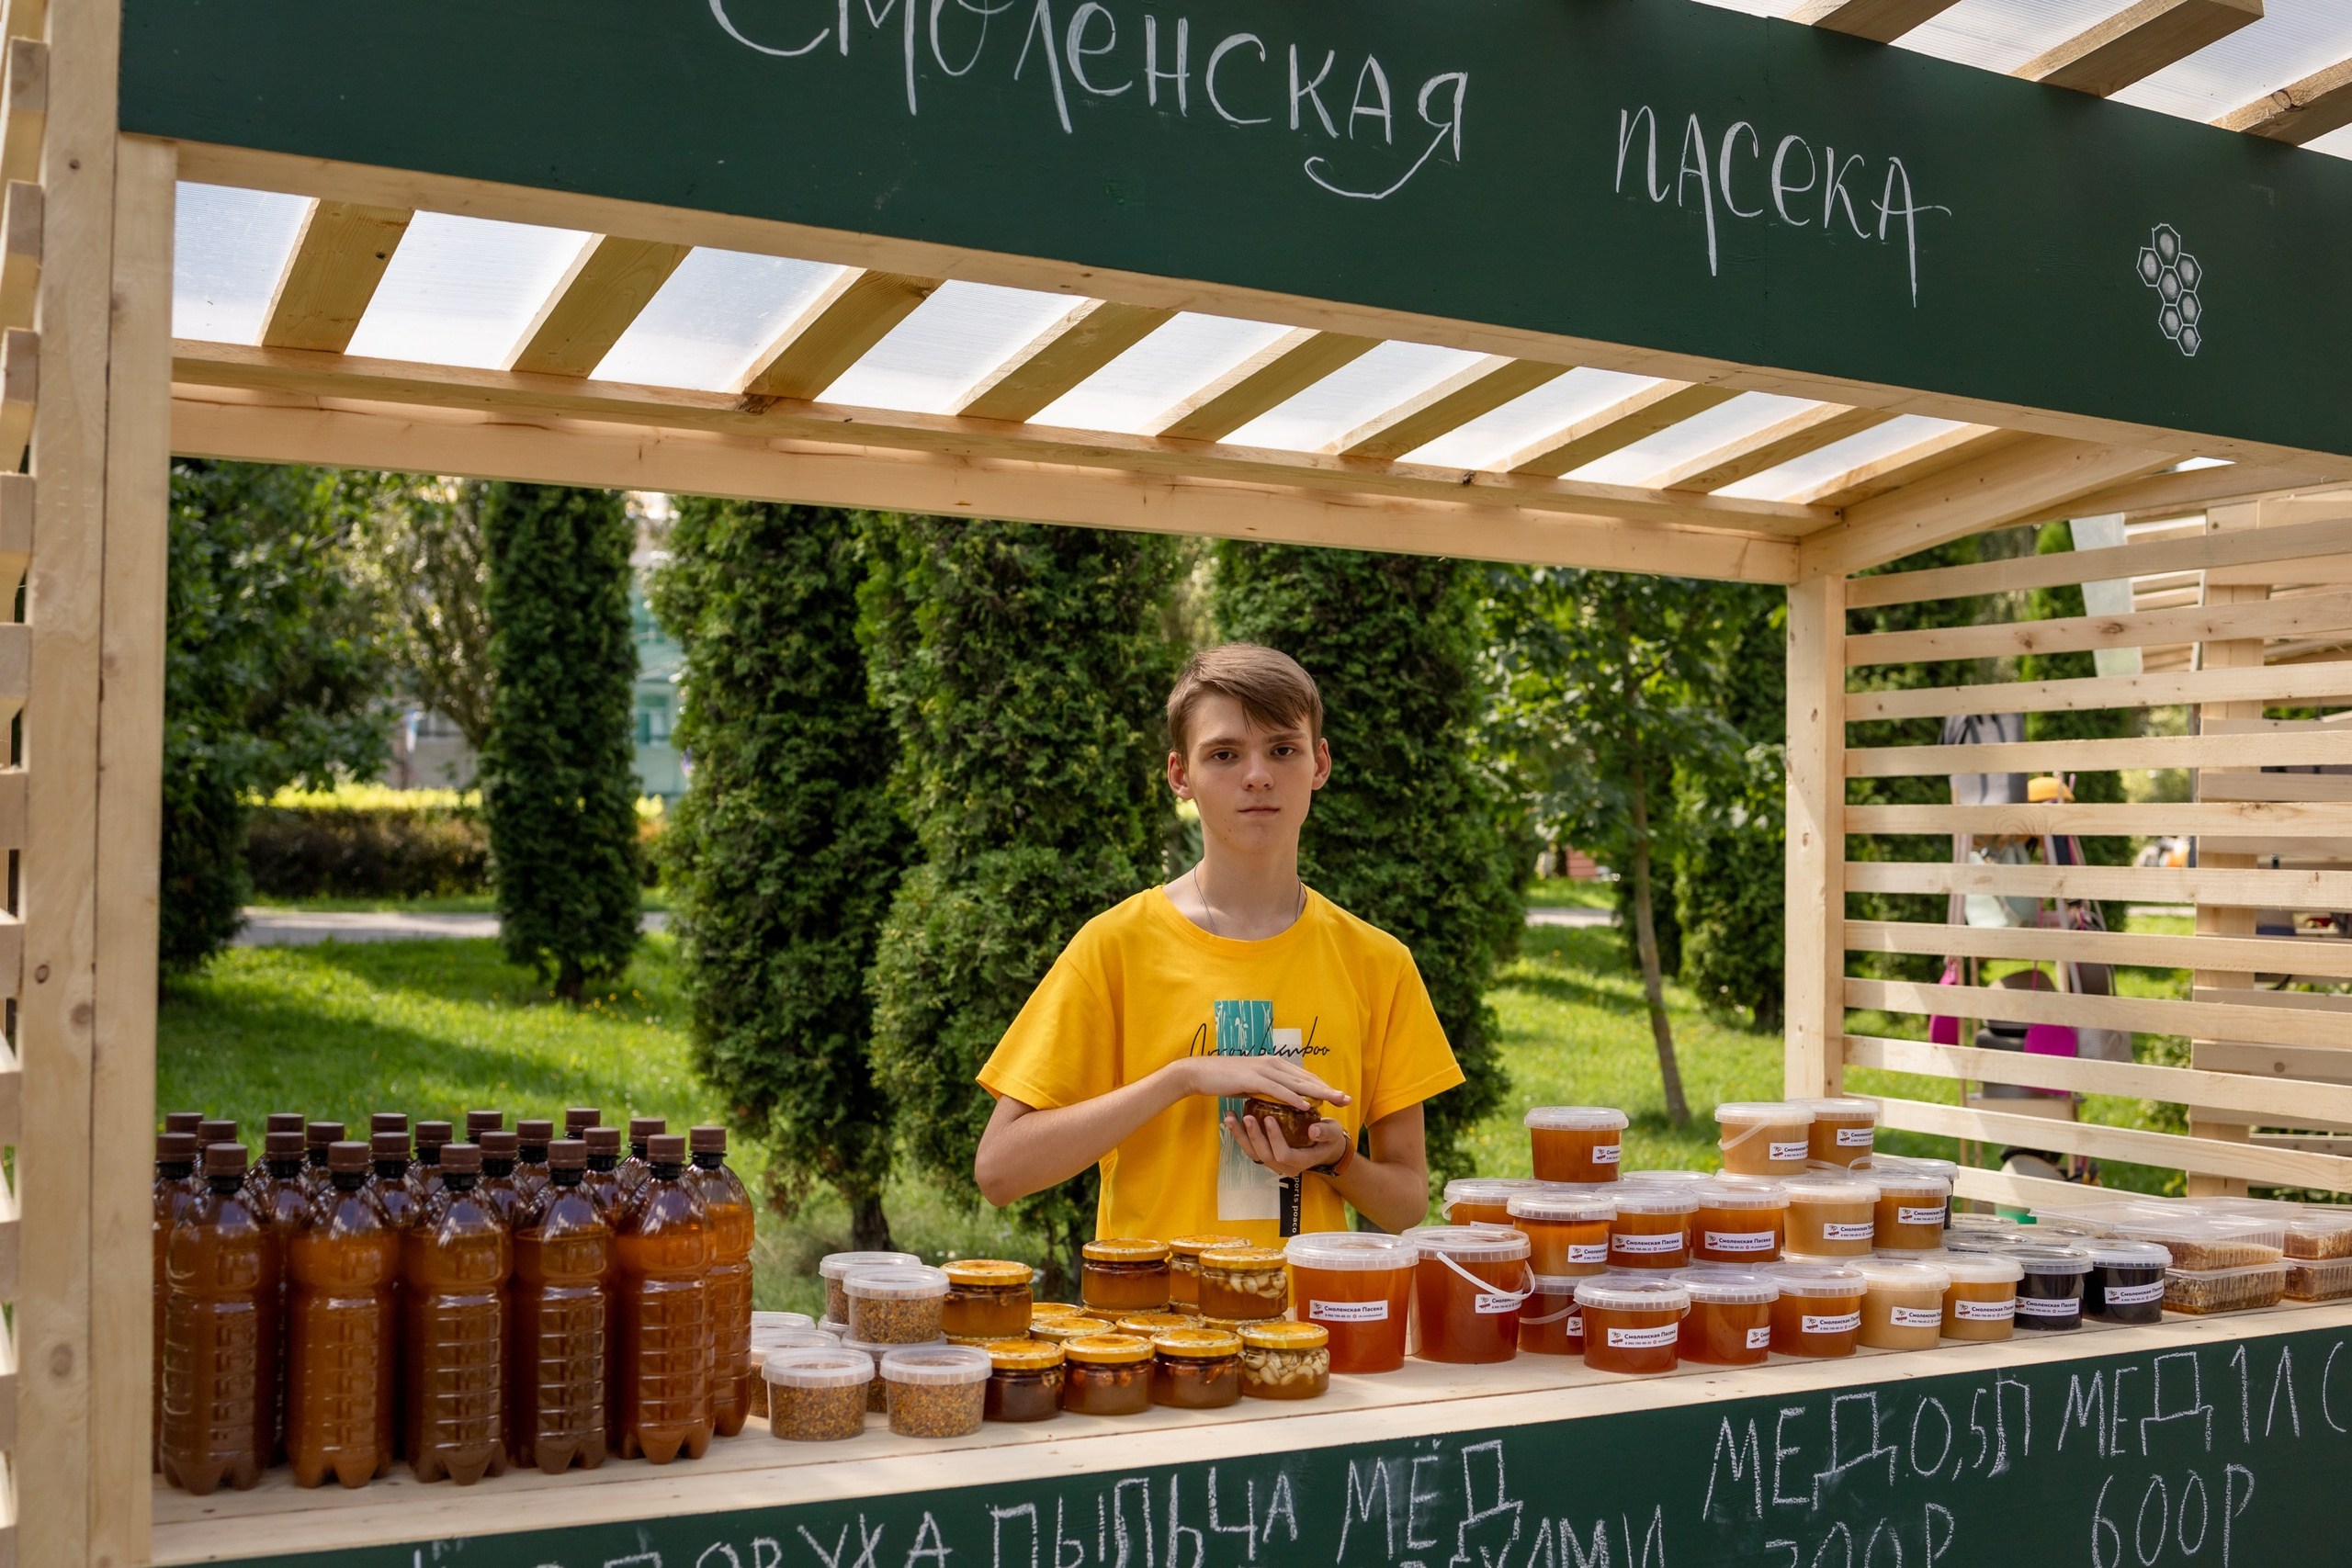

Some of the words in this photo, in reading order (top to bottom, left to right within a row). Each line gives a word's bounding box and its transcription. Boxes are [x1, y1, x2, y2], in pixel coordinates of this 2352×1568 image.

[1292, 1173, 1300, 1203] ports
[1702, 1392, 1898, 1523] МЕД
[2057, 1351, 2214, 1459] МЕД
[1337, 1438, 1524, 1564] МЁД
[2092, 1463, 2255, 1568] 600Р
